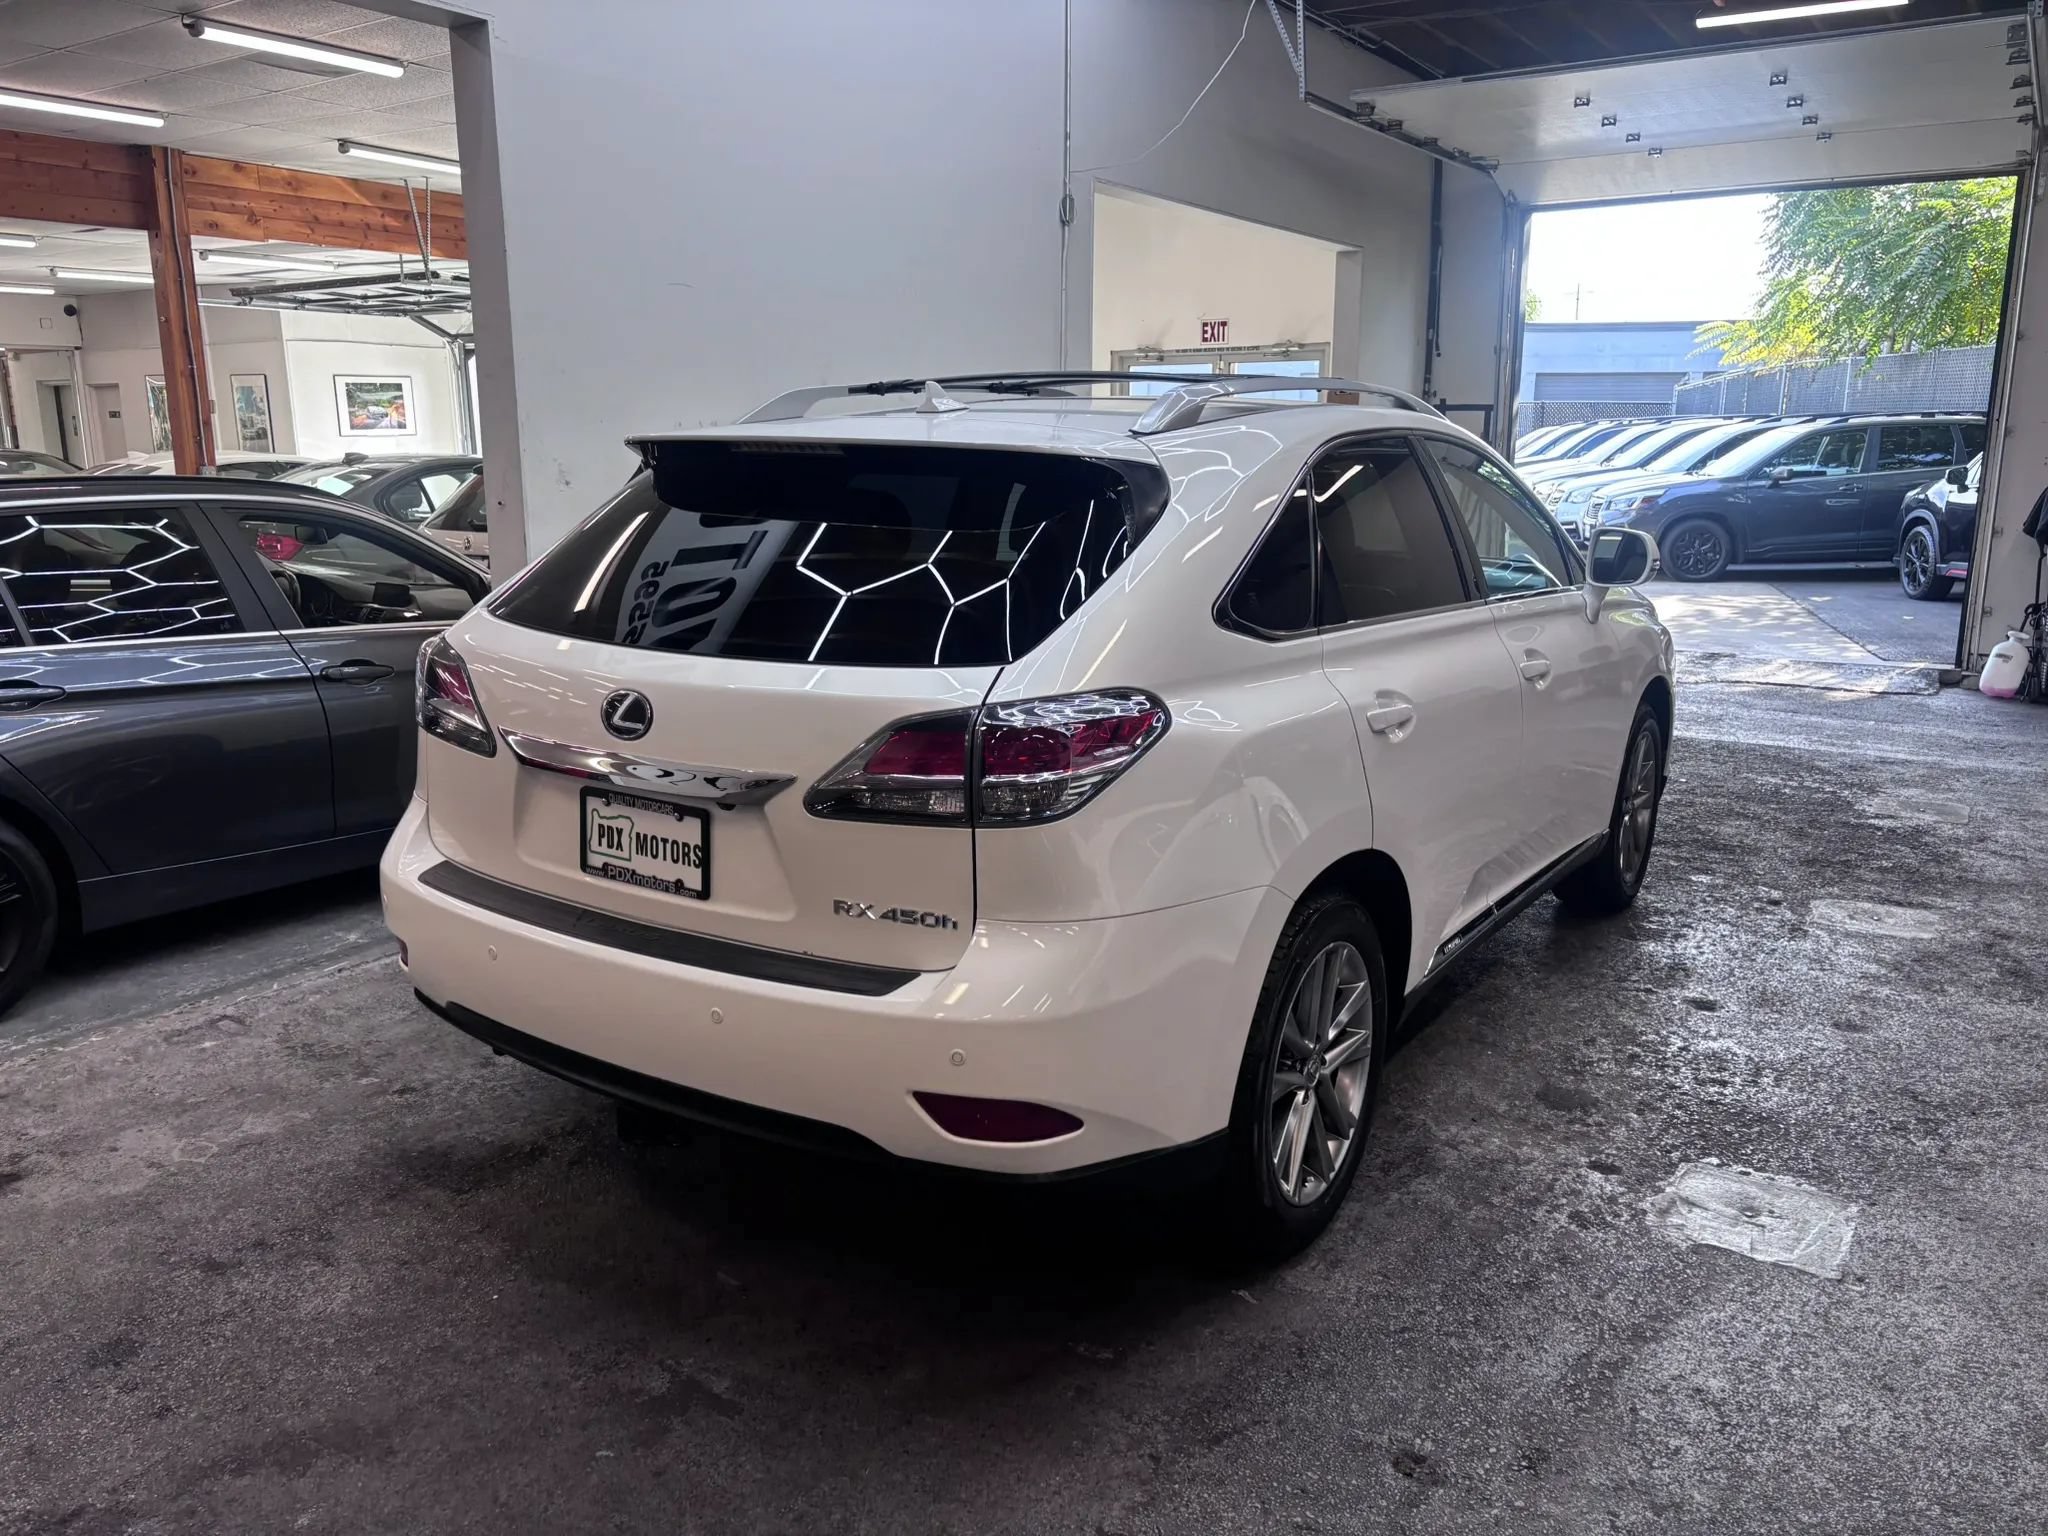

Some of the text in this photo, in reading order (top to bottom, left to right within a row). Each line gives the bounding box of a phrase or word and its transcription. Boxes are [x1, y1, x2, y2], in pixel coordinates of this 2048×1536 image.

[1201, 321, 1228, 343] EXIT
[608, 792, 674, 817] QUALITY MOTORCARS
[597, 823, 702, 869] PDX MOTORS
[832, 898, 959, 931] RX 450h
